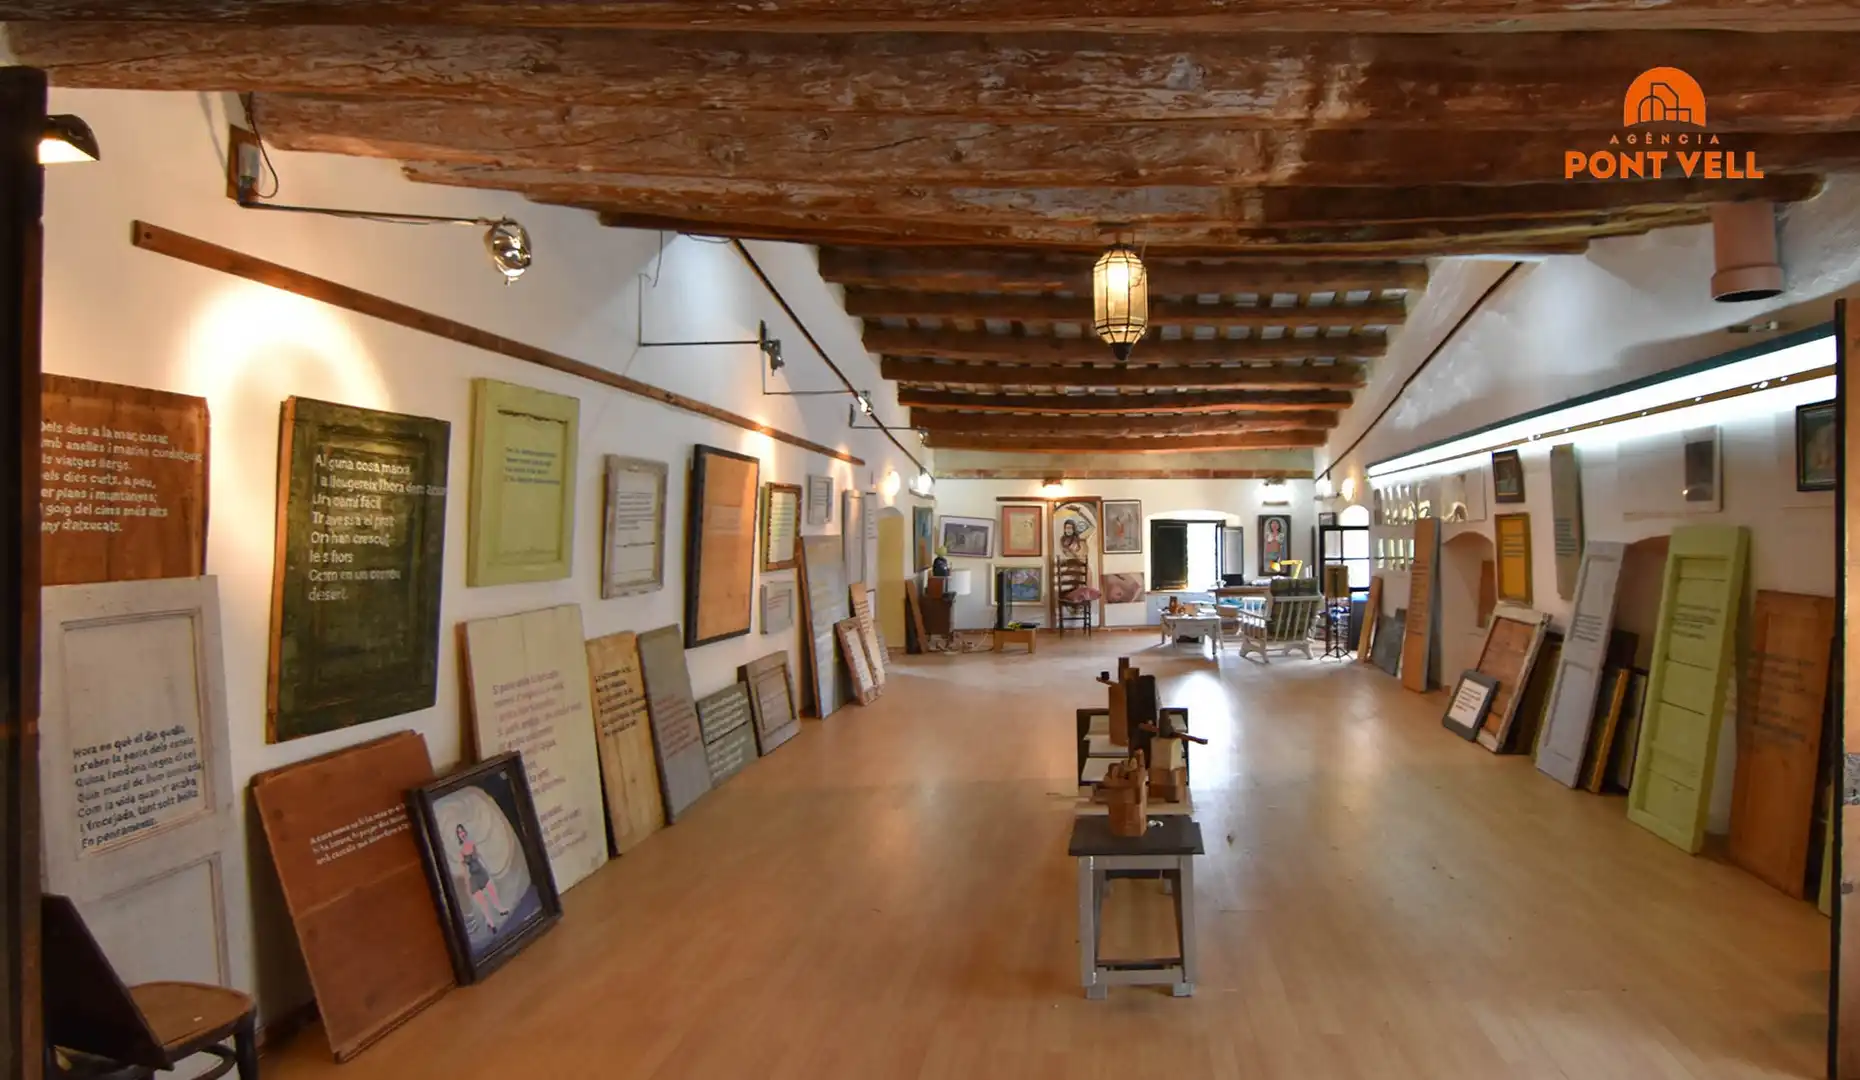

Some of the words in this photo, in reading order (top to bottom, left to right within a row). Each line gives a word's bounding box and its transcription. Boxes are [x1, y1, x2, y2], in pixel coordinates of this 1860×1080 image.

[92, 428, 100, 438] a
[102, 425, 112, 438] la
[107, 443, 112, 453] i
[56, 455, 97, 470] viatges
[356, 460, 380, 473] cosa
[63, 471, 87, 483] dies
[90, 488, 94, 500] i
[46, 503, 71, 516] goig
[74, 502, 92, 515] del
[310, 531, 329, 544] On
[77, 805, 101, 818] Com
